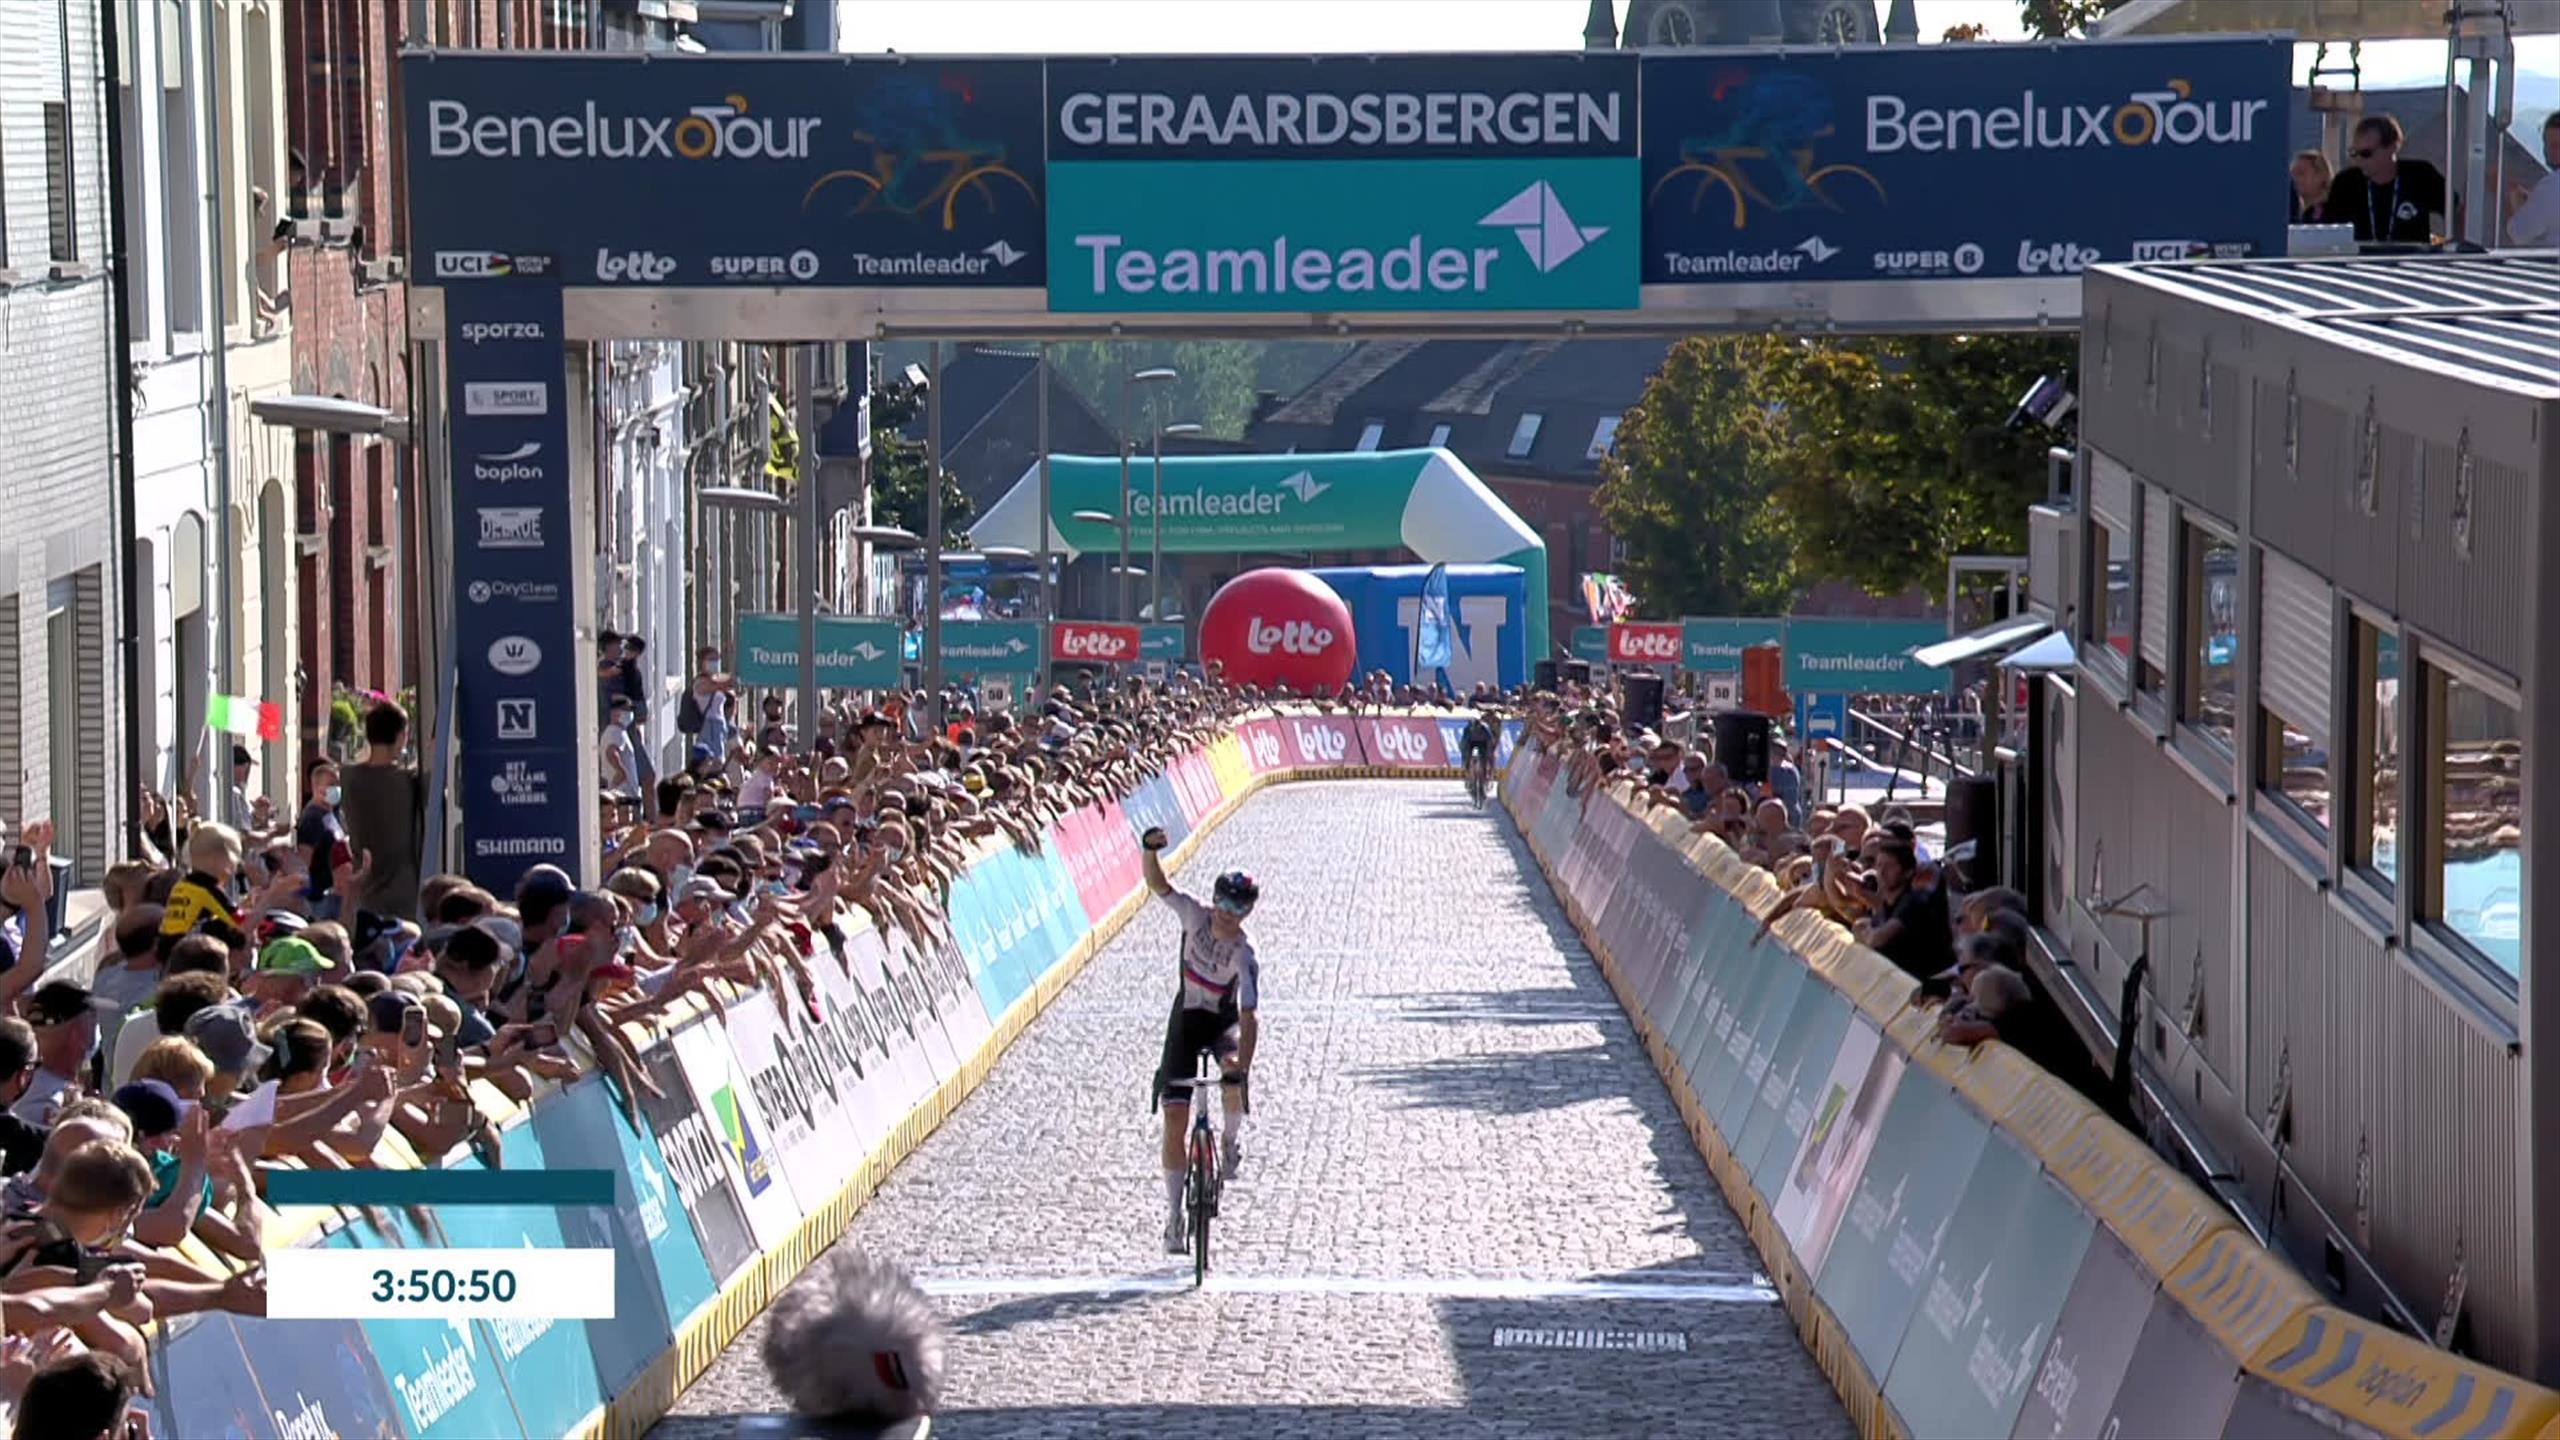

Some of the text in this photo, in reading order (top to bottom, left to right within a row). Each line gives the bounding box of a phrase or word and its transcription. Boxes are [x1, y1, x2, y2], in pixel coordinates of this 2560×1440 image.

[1060, 92, 1620, 145] GERAARDSBERGEN
[441, 257, 482, 273] UCI
[711, 257, 785, 273] SUPER
[853, 252, 990, 275] Teamleader
[1075, 234, 1499, 293] Teamleader
[1664, 249, 1803, 274] Teamleader
[1874, 252, 1949, 268] SUPER
[475, 464, 542, 483] boplan
[750, 647, 856, 667] Teamader
[1800, 653, 1906, 671] Teamleader
[502, 704, 532, 730] N
[476, 839, 565, 855] SHIMANO
